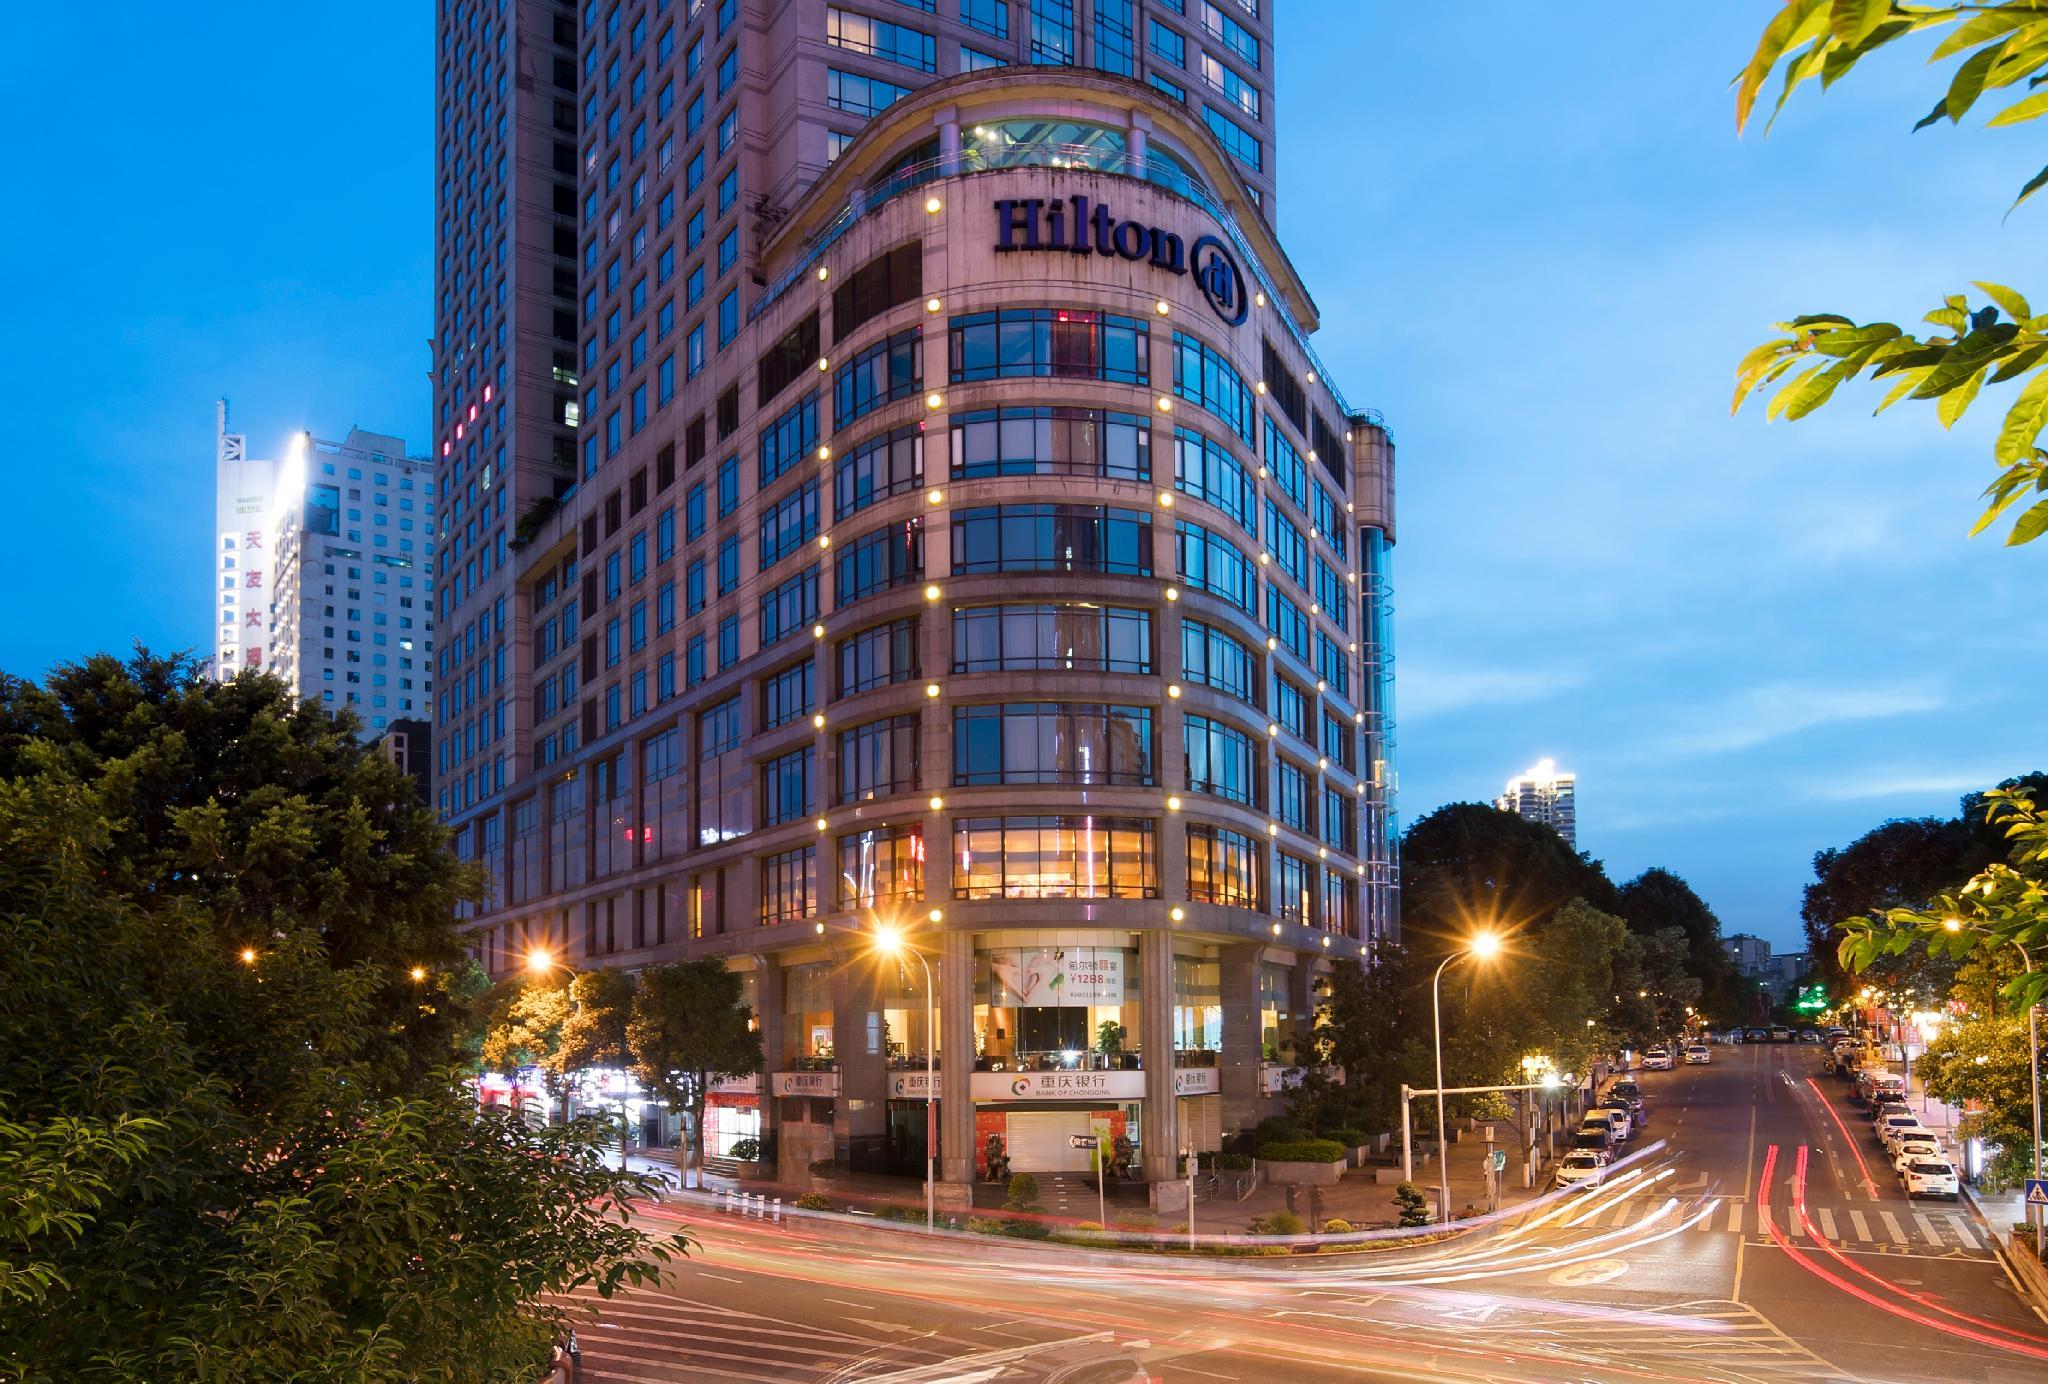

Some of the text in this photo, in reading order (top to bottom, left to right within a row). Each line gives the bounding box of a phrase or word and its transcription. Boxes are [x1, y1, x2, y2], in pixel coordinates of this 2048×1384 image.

[994, 195, 1187, 276] Hilton
[1041, 1074, 1105, 1088] 重庆银行
